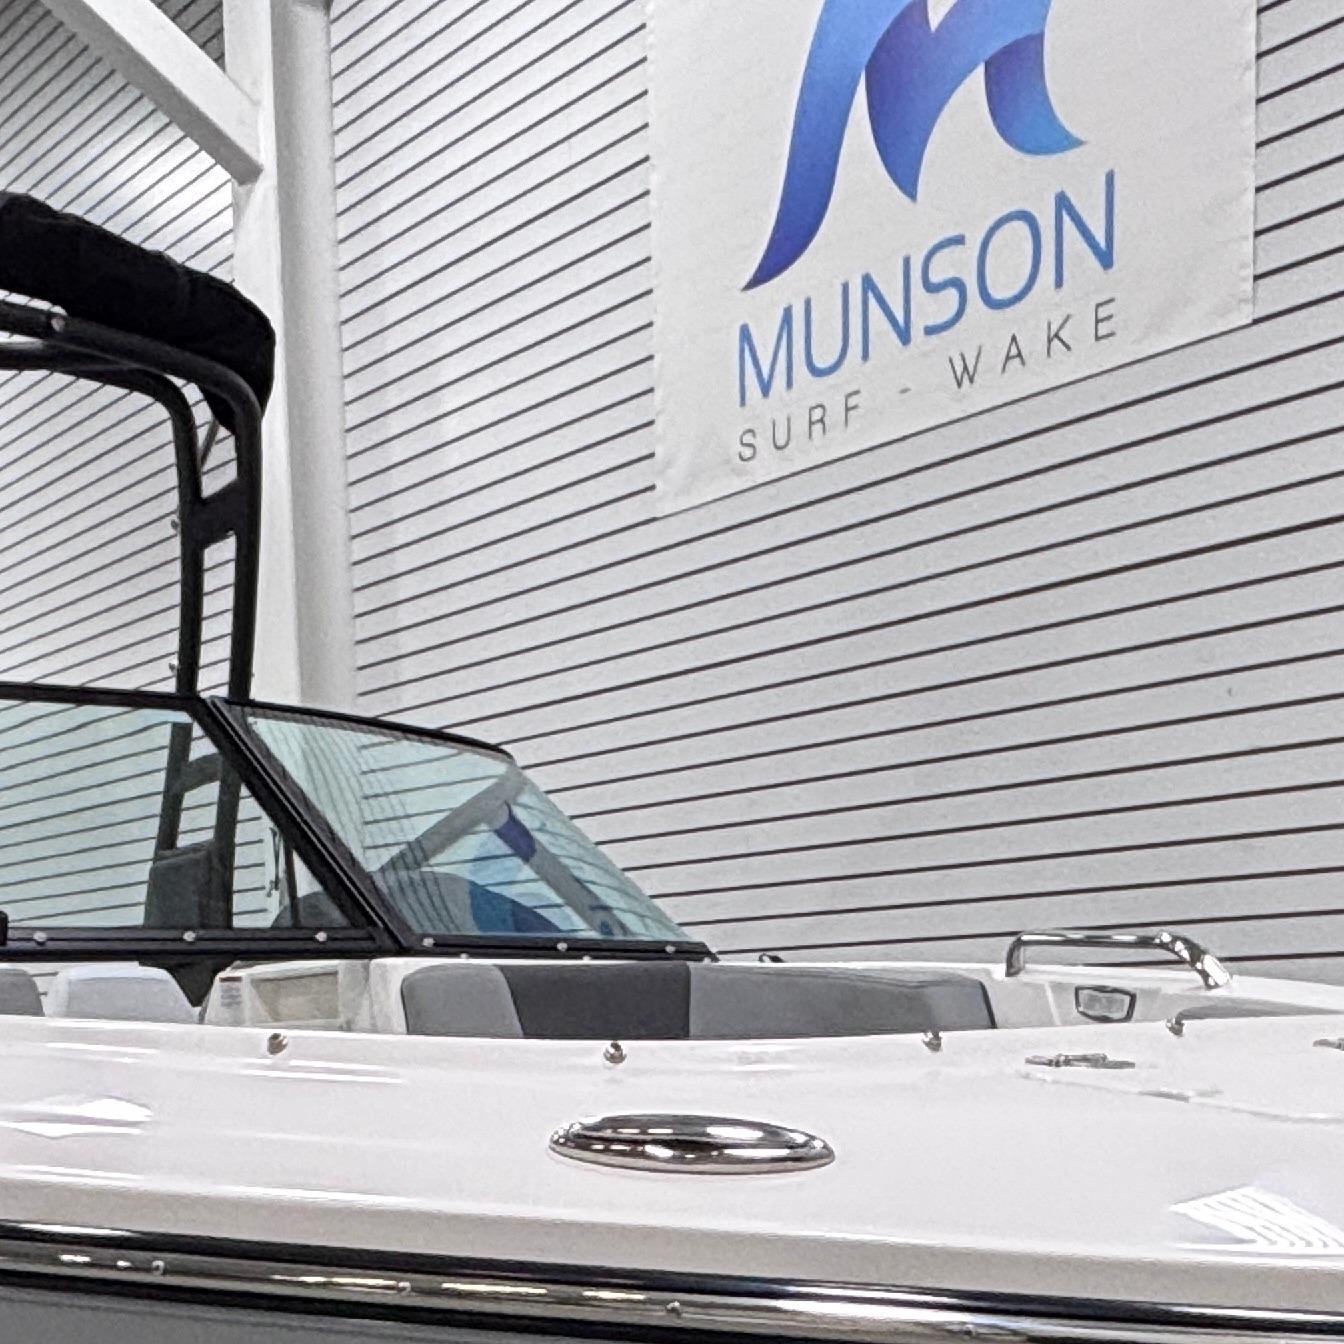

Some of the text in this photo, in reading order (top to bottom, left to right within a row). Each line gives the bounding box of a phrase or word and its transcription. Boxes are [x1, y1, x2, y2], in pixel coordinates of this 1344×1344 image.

[738, 389, 862, 463] SURF
[948, 297, 1117, 390] WAKE
[739, 169, 1115, 408] MUNSON
